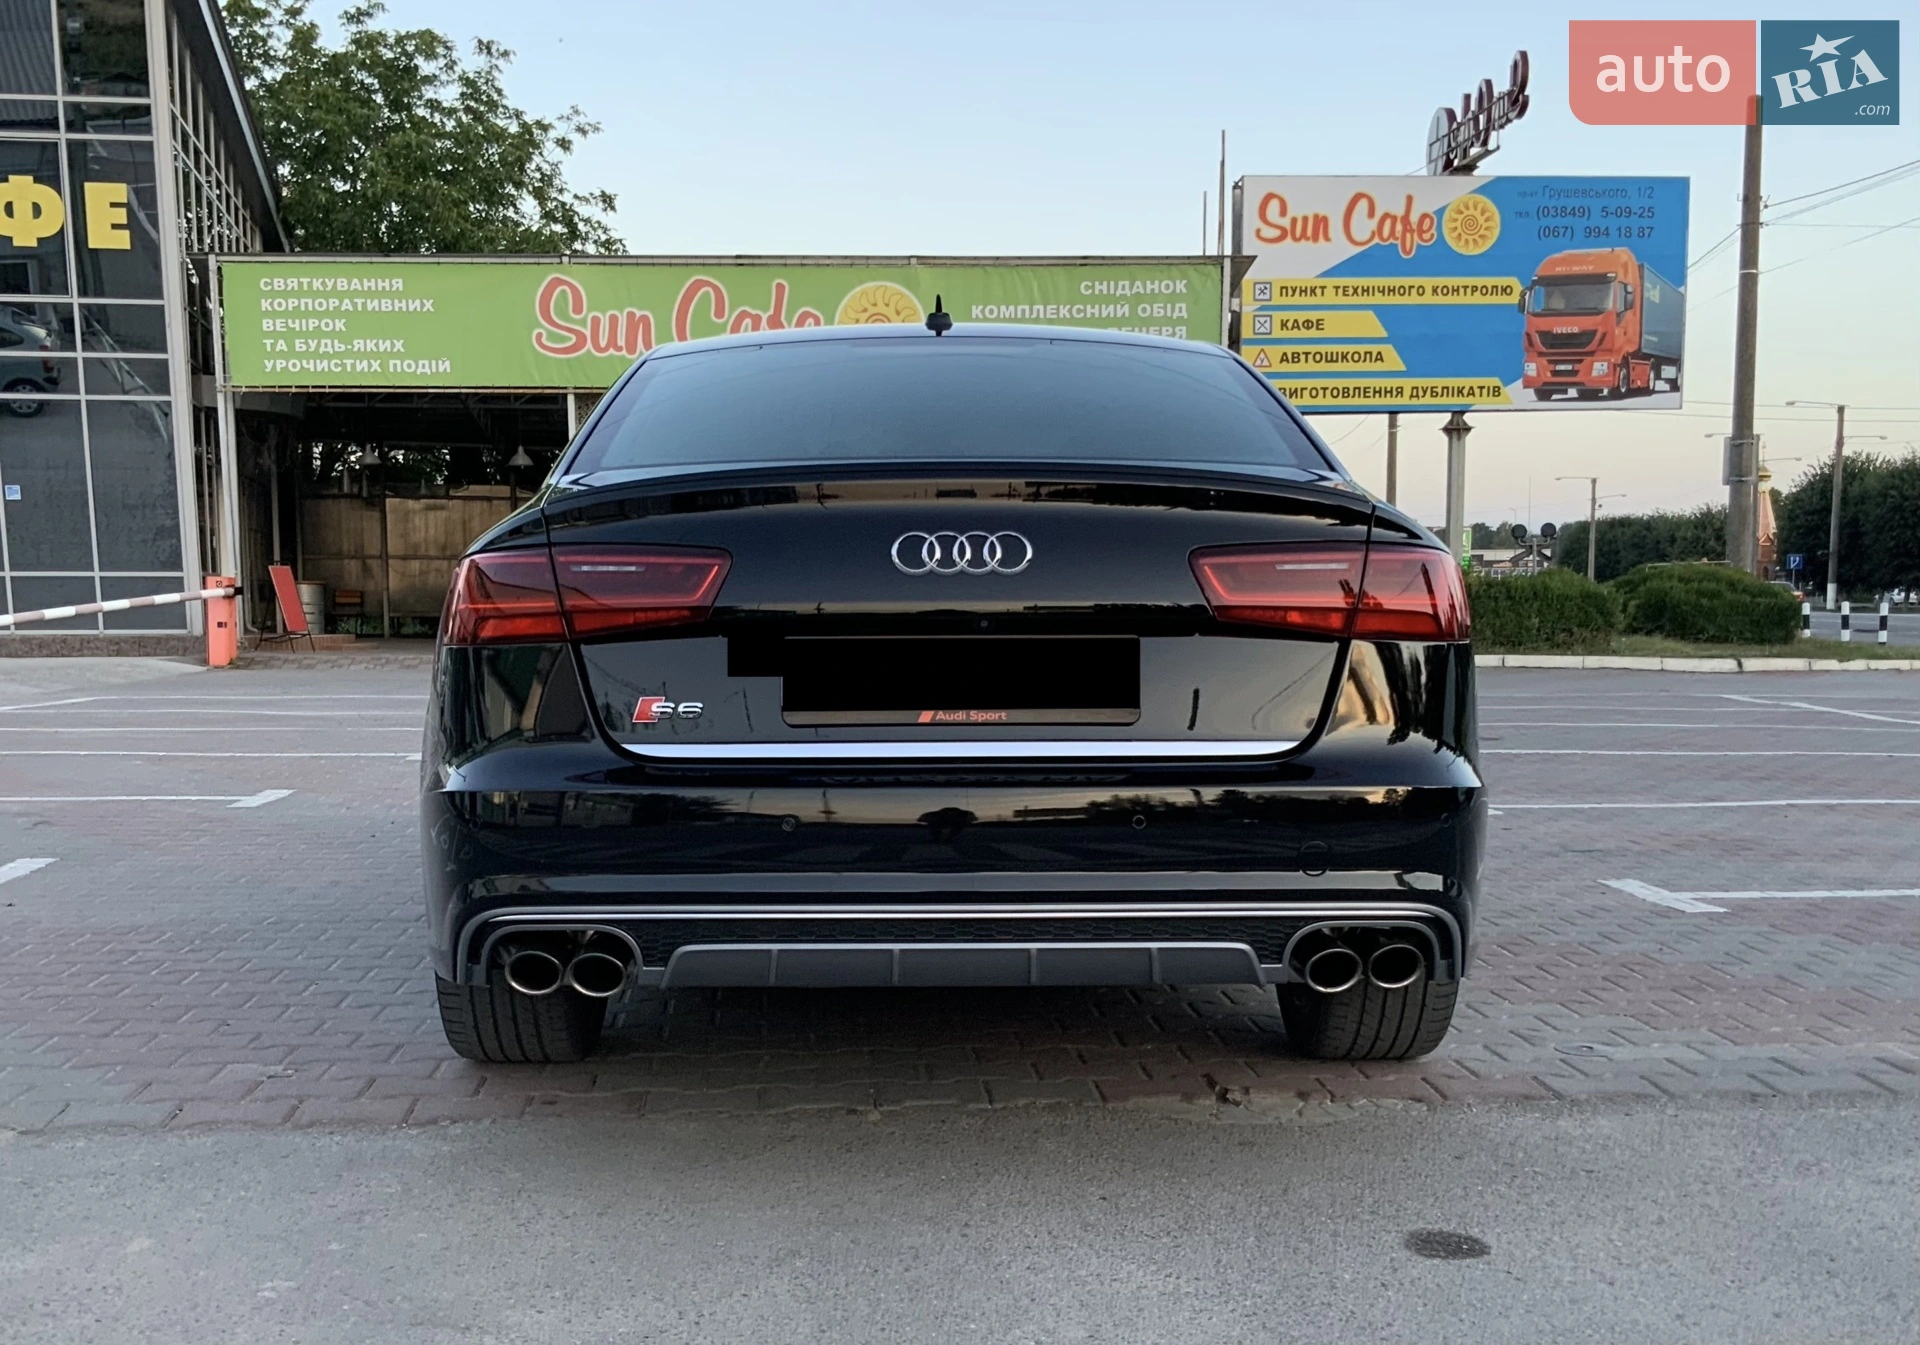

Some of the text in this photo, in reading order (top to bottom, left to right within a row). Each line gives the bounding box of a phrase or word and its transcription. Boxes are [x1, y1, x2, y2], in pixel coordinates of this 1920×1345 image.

[1542, 184, 1632, 201] Грушевського,
[1636, 185, 1655, 200] 1/2
[1536, 205, 1592, 221] (03849)
[1600, 205, 1656, 220] 5-09-25
[1255, 191, 1436, 258] Sun Cafe
[1537, 225, 1655, 241] (067) 994 18 87
[259, 277, 404, 292] СВЯТКУВАННЯ
[1079, 279, 1188, 297] СНІДАНОК
[1279, 284, 1514, 298] ПУНКТ ТЕХНІЧНОГО КОНТРОЛЮ
[260, 298, 435, 312] КОРПОРАТИВНИХ
[971, 301, 1188, 320] КОМПЛЕКСНИЙ ОБІД
[533, 274, 656, 357] Sun
[262, 318, 347, 332] ВЕЧІРОК
[1280, 318, 1325, 332] КАФЕ
[1553, 326, 1579, 335] IVECO
[262, 338, 405, 354] ТА БУДЬ-ЯКИХ
[1279, 350, 1385, 365] АВТОШКОЛА
[263, 357, 451, 375] УРОЧИСТИХ ПОДІЙ
[1408, 384, 1502, 401] ДУБЛІКАТІВ
[646, 701, 704, 720] S6
[935, 709, 1008, 723] Audi Sport
